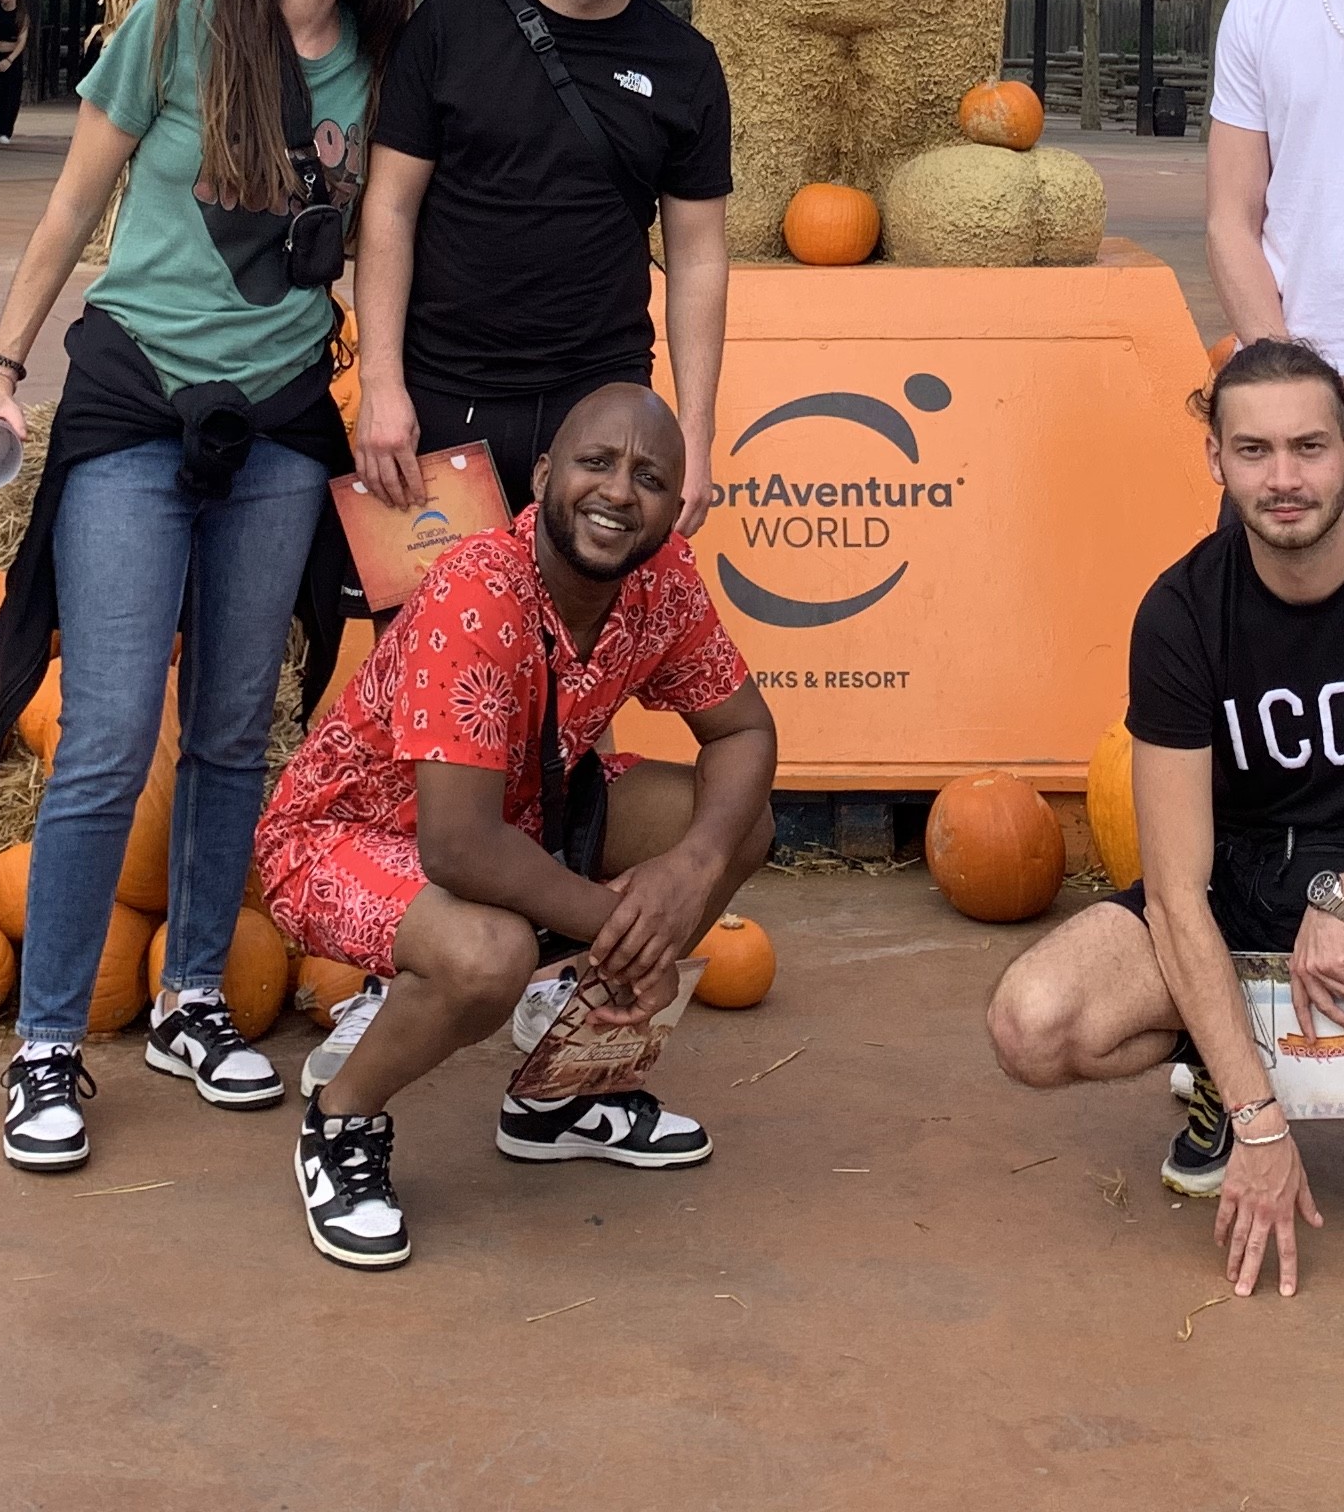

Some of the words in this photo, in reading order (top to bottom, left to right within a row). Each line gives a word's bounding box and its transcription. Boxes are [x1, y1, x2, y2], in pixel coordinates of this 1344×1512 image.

[710, 473, 953, 508] ortAventura
[416, 527, 448, 541] WORLD
[741, 517, 890, 549] WORLD
[756, 671, 798, 689] RKS
[804, 671, 818, 689] &
[824, 671, 910, 689] RESORT
